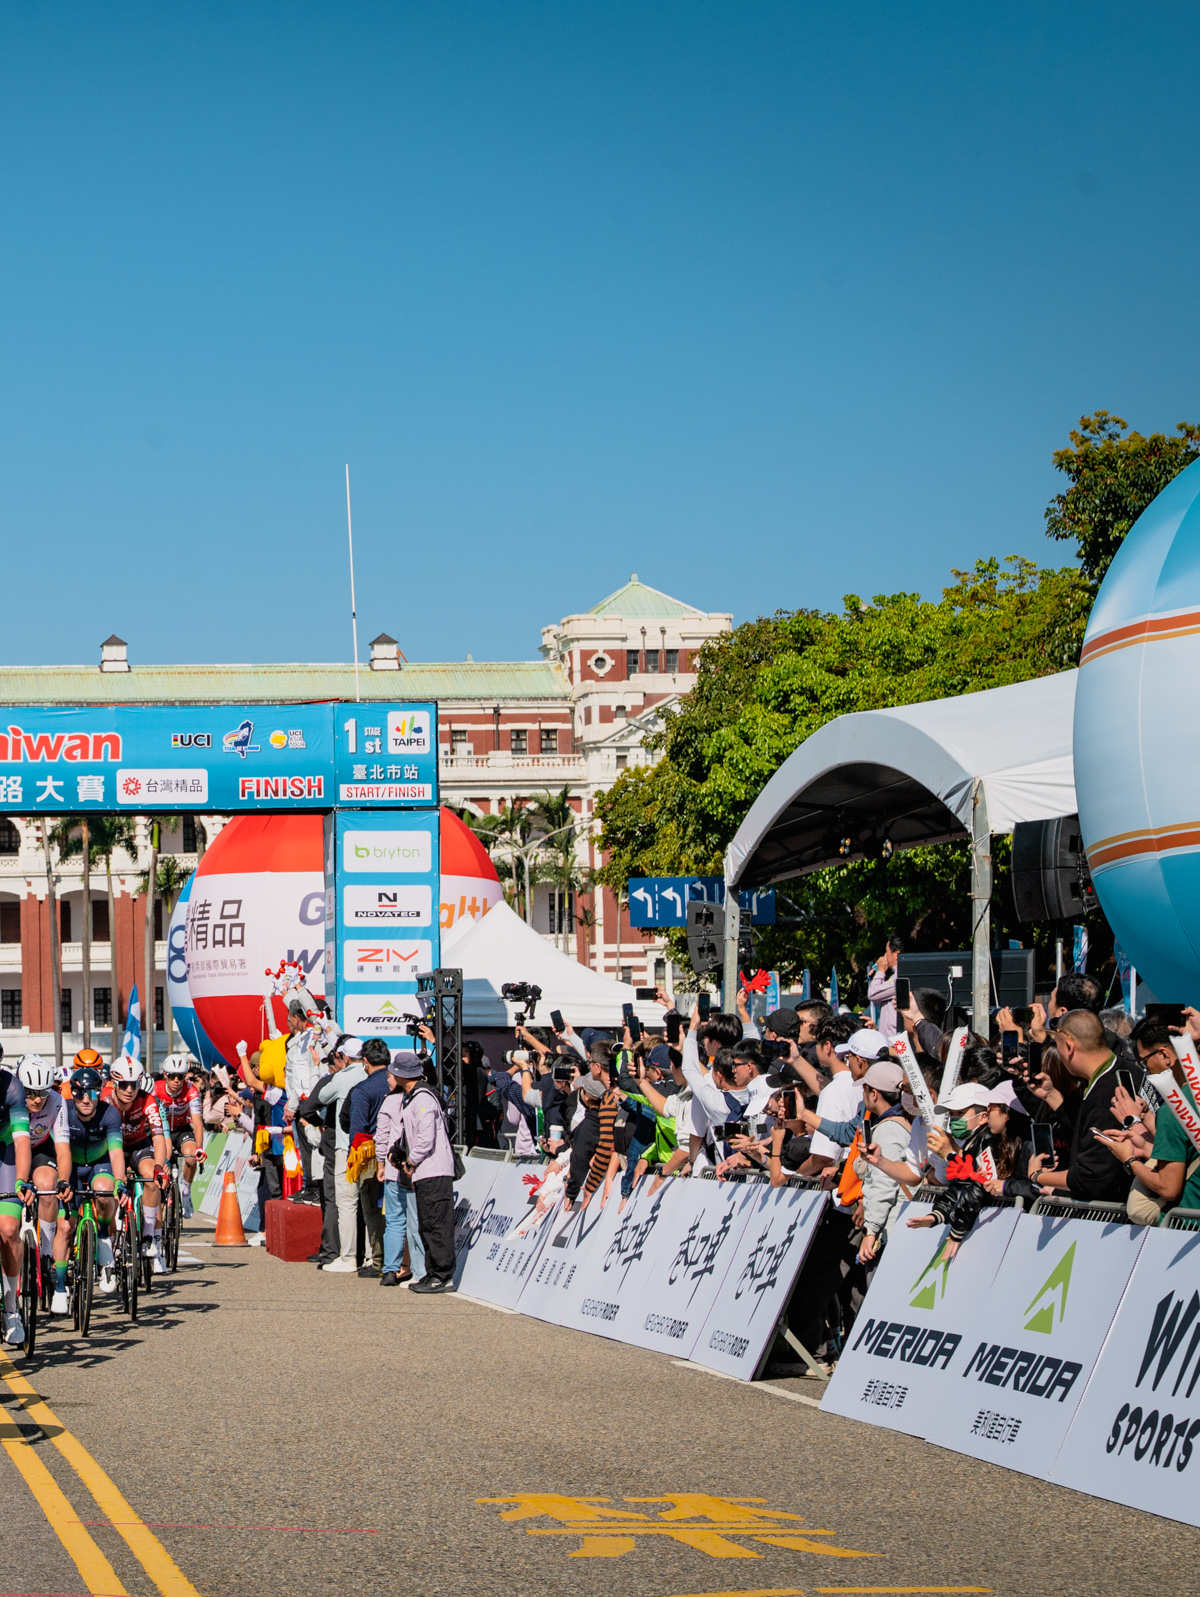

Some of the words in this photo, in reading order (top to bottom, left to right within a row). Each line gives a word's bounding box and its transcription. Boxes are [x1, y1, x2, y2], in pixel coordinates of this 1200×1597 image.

[180, 734, 211, 748] UCI
[344, 718, 357, 754] 1
[364, 738, 382, 754] st
[364, 727, 381, 736] STAGE
[393, 738, 426, 746] TAIPEI
[352, 764, 419, 780] 臺北市站
[146, 778, 204, 794] 台灣精品
[239, 776, 324, 799] FINISH
[346, 786, 425, 798] START/FINISH
[373, 846, 420, 860] bryton
[378, 892, 397, 902] N
[357, 948, 419, 962] ZIV
[1167, 1088, 1200, 1147] TAIWA
[483, 1213, 514, 1238] BODYWRAP
[552, 1200, 604, 1250] ZIV
[852, 1318, 962, 1370] MERIDA
[962, 1342, 1083, 1403] MERIDA
[860, 1378, 909, 1410] 美利達自行車
[970, 1408, 1023, 1446] 美利達自行車
[1105, 1402, 1200, 1473] SPORTS
